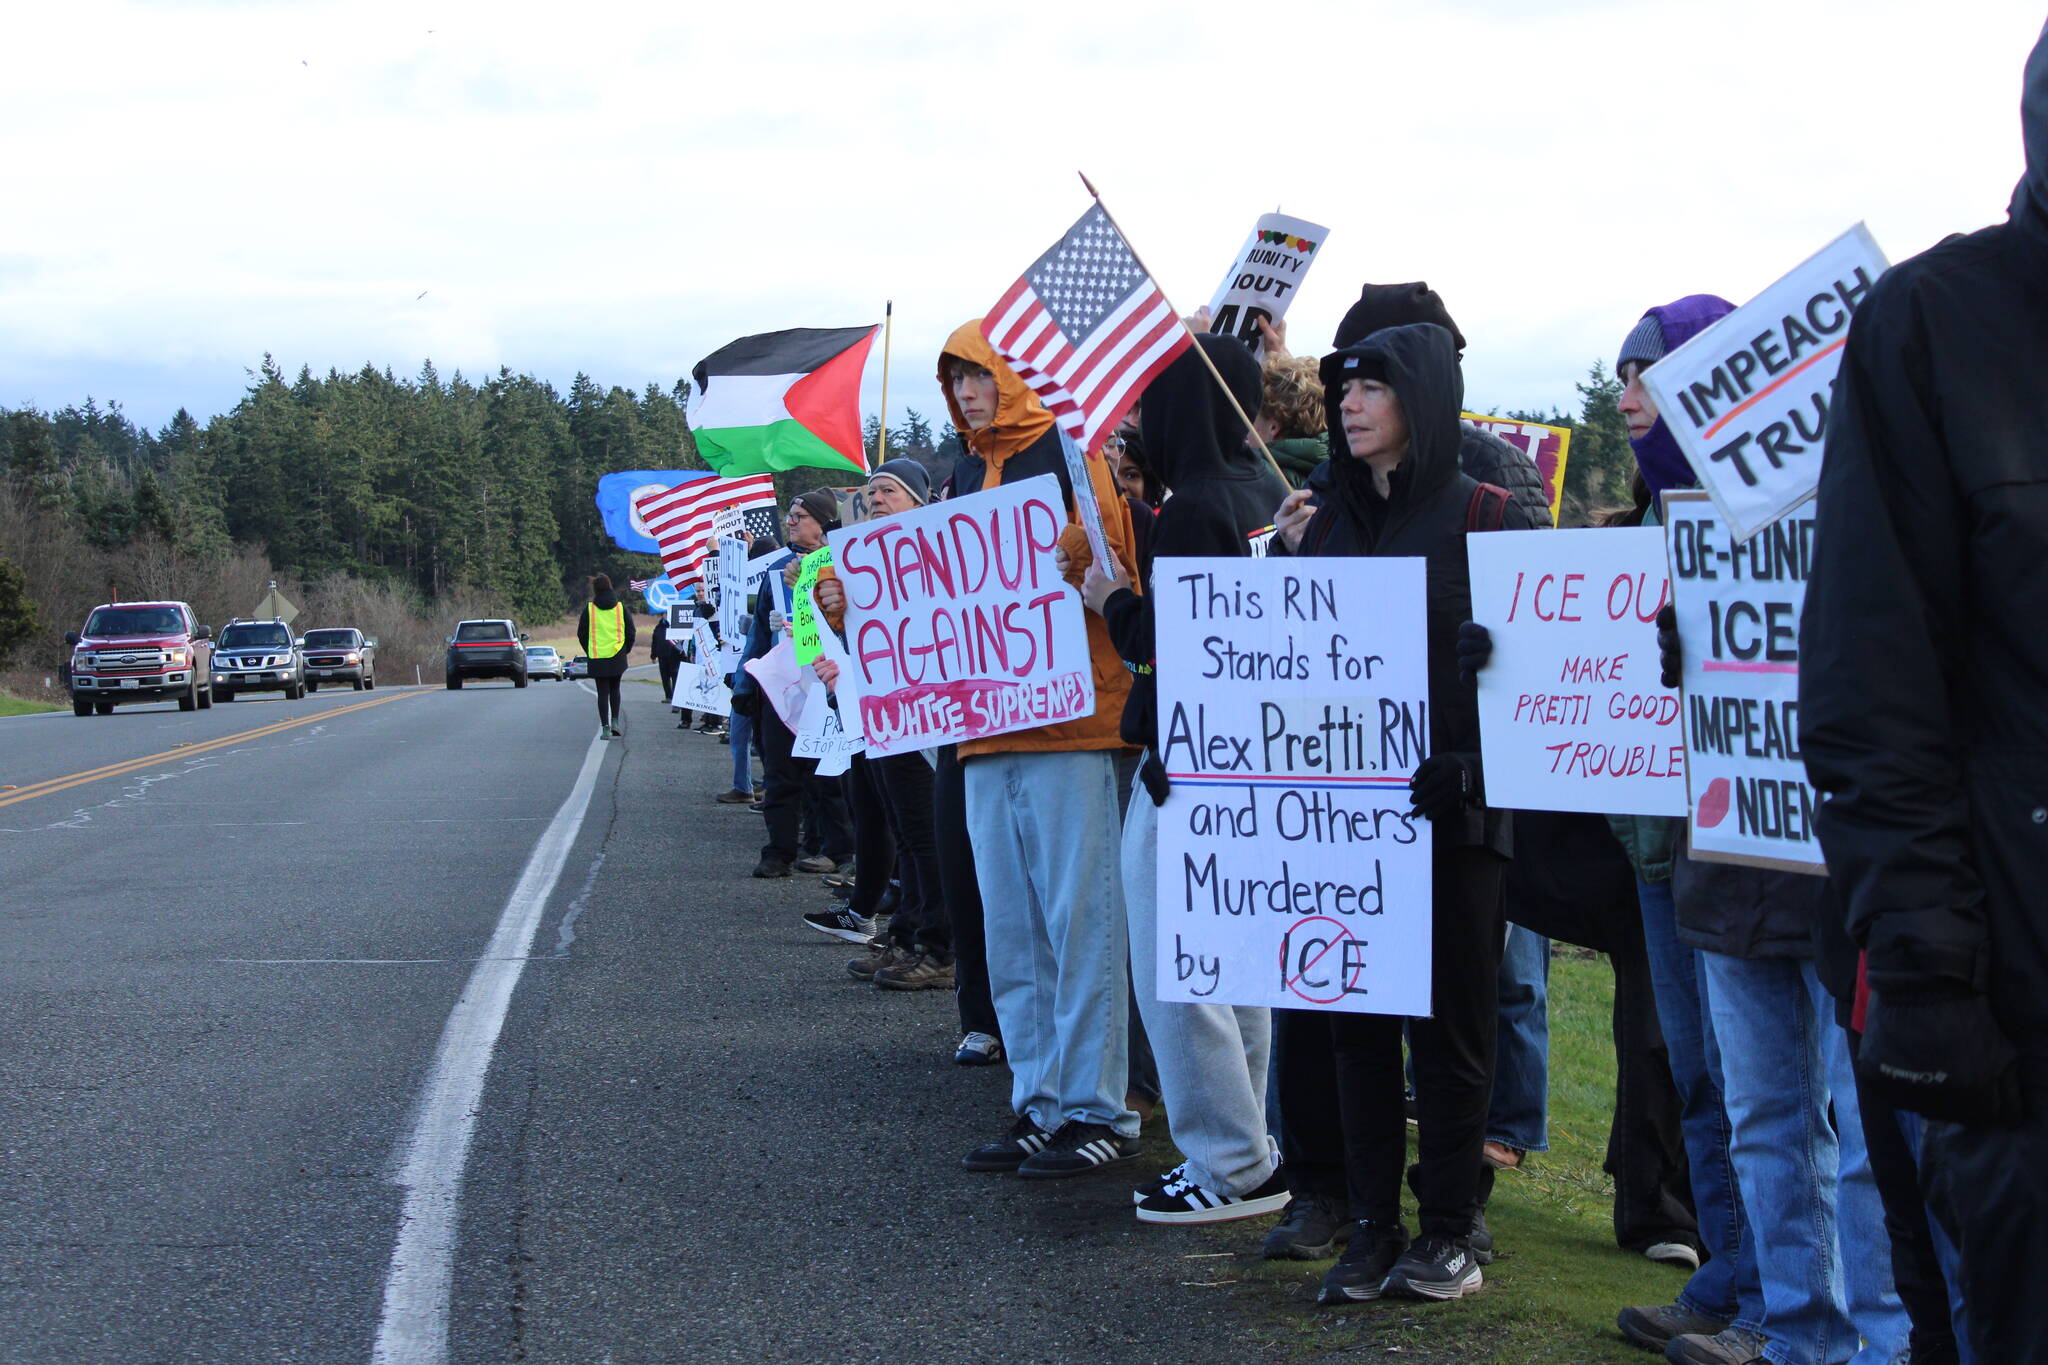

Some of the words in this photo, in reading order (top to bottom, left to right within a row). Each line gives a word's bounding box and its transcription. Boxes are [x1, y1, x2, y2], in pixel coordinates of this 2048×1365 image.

[1676, 266, 1874, 429] IMPEACH
[1709, 379, 1836, 487] TRU
[1177, 572, 1264, 620] This
[1284, 576, 1338, 622] RN
[1507, 572, 1586, 623] ICE
[857, 591, 1066, 686] AGAINST
[1202, 635, 1310, 681] Stands
[1326, 633, 1384, 681] for
[1708, 600, 1799, 663] ICE
[1560, 653, 1629, 684] MAKE
[867, 692, 967, 744] WHITE
[1163, 700, 1253, 773] Alex
[1513, 693, 1592, 726] PRETTI
[1608, 691, 1680, 726] GOOD
[1545, 740, 1684, 779] TROUBLE
[1189, 784, 1258, 838] and
[1276, 790, 1417, 845] Others
[1183, 851, 1384, 916] Murdered
[1174, 933, 1221, 997] by
[1280, 932, 1368, 994] ICE
[1444, 1252, 1467, 1277] HOKA
